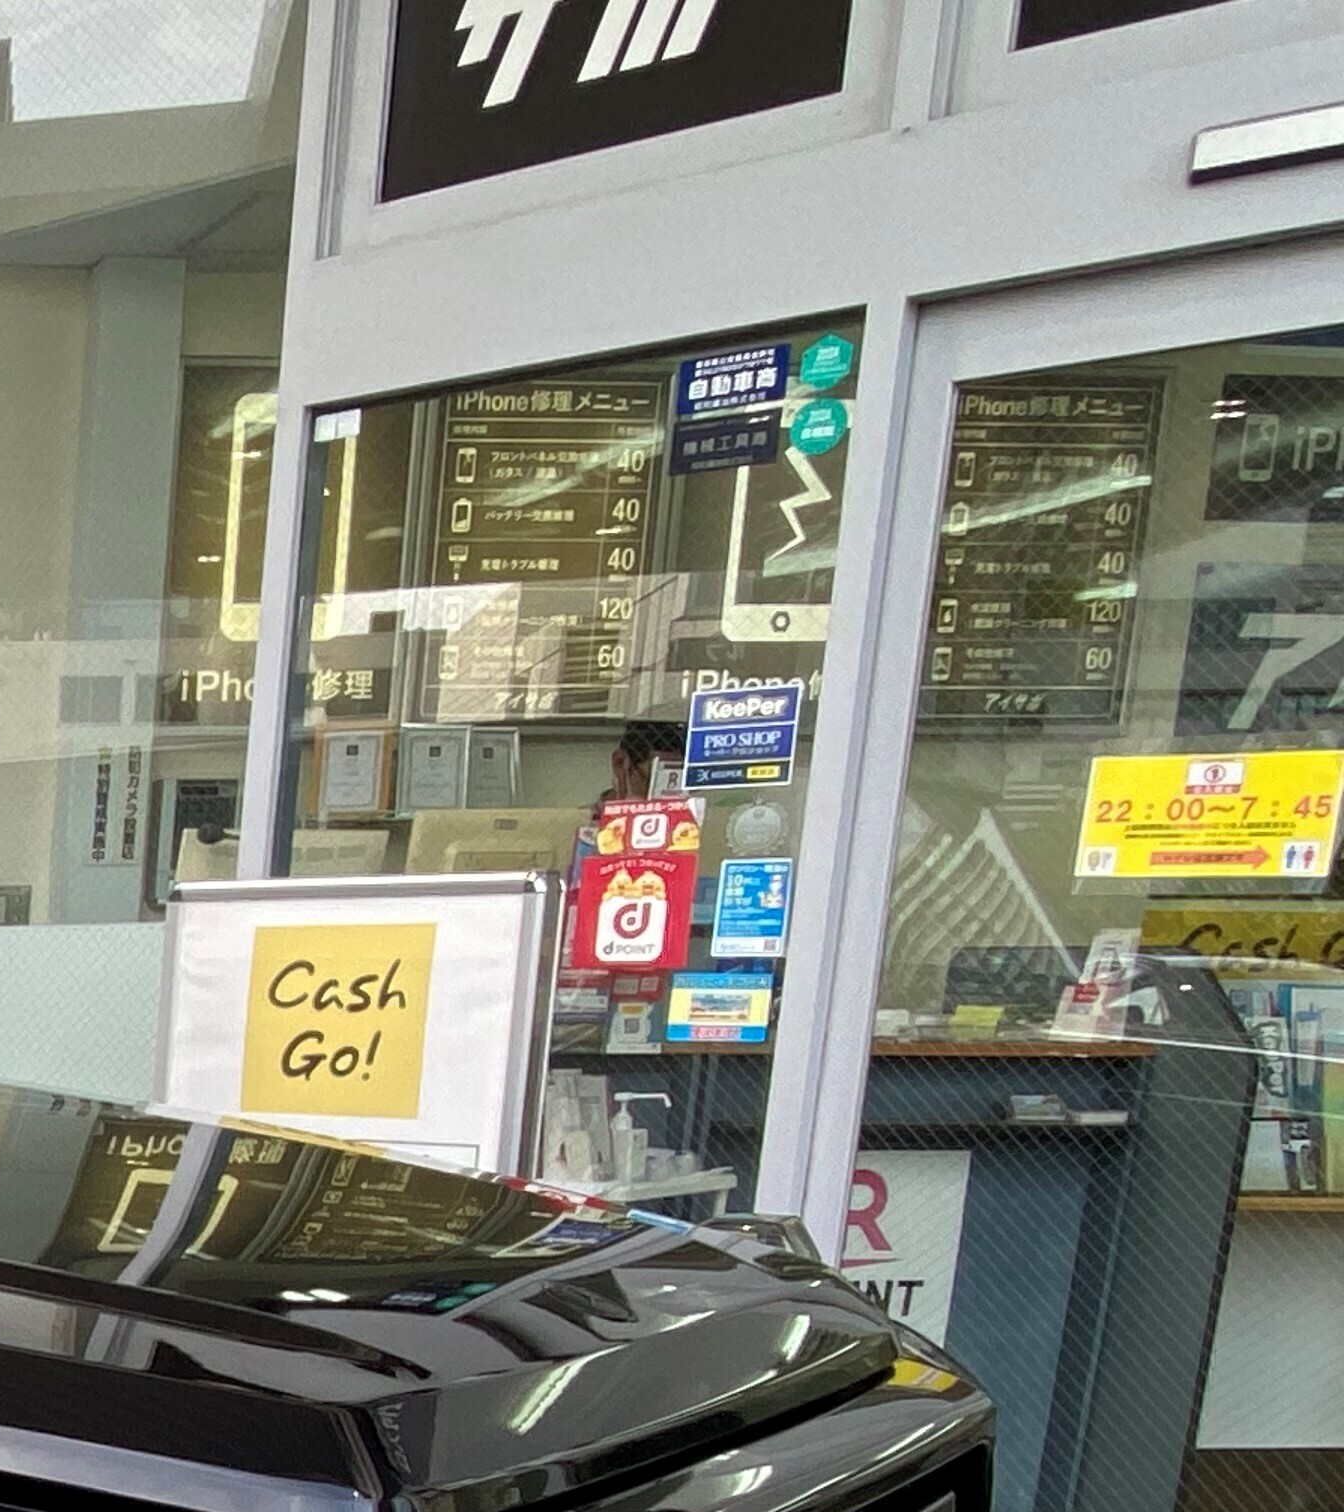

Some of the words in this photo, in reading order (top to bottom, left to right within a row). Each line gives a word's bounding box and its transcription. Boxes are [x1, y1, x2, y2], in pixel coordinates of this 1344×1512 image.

[688, 367, 778, 400] 自動車商
[457, 390, 650, 412] iPhone修理メニュー
[1291, 427, 1344, 471] iP
[616, 449, 644, 472] 40
[1112, 453, 1138, 476] 40
[612, 498, 640, 521] 40
[1105, 503, 1131, 525] 40
[607, 548, 635, 570] 40
[1098, 552, 1125, 573] 40
[599, 598, 634, 618] 120
[1088, 602, 1121, 622] 120
[598, 645, 625, 667] 60
[1085, 648, 1111, 669] 60
[704, 697, 787, 720] KeePer
[704, 734, 736, 749] PRO
[738, 730, 782, 747] SHOP
[268, 958, 407, 1013] Cash
[281, 1030, 381, 1081] Go!
